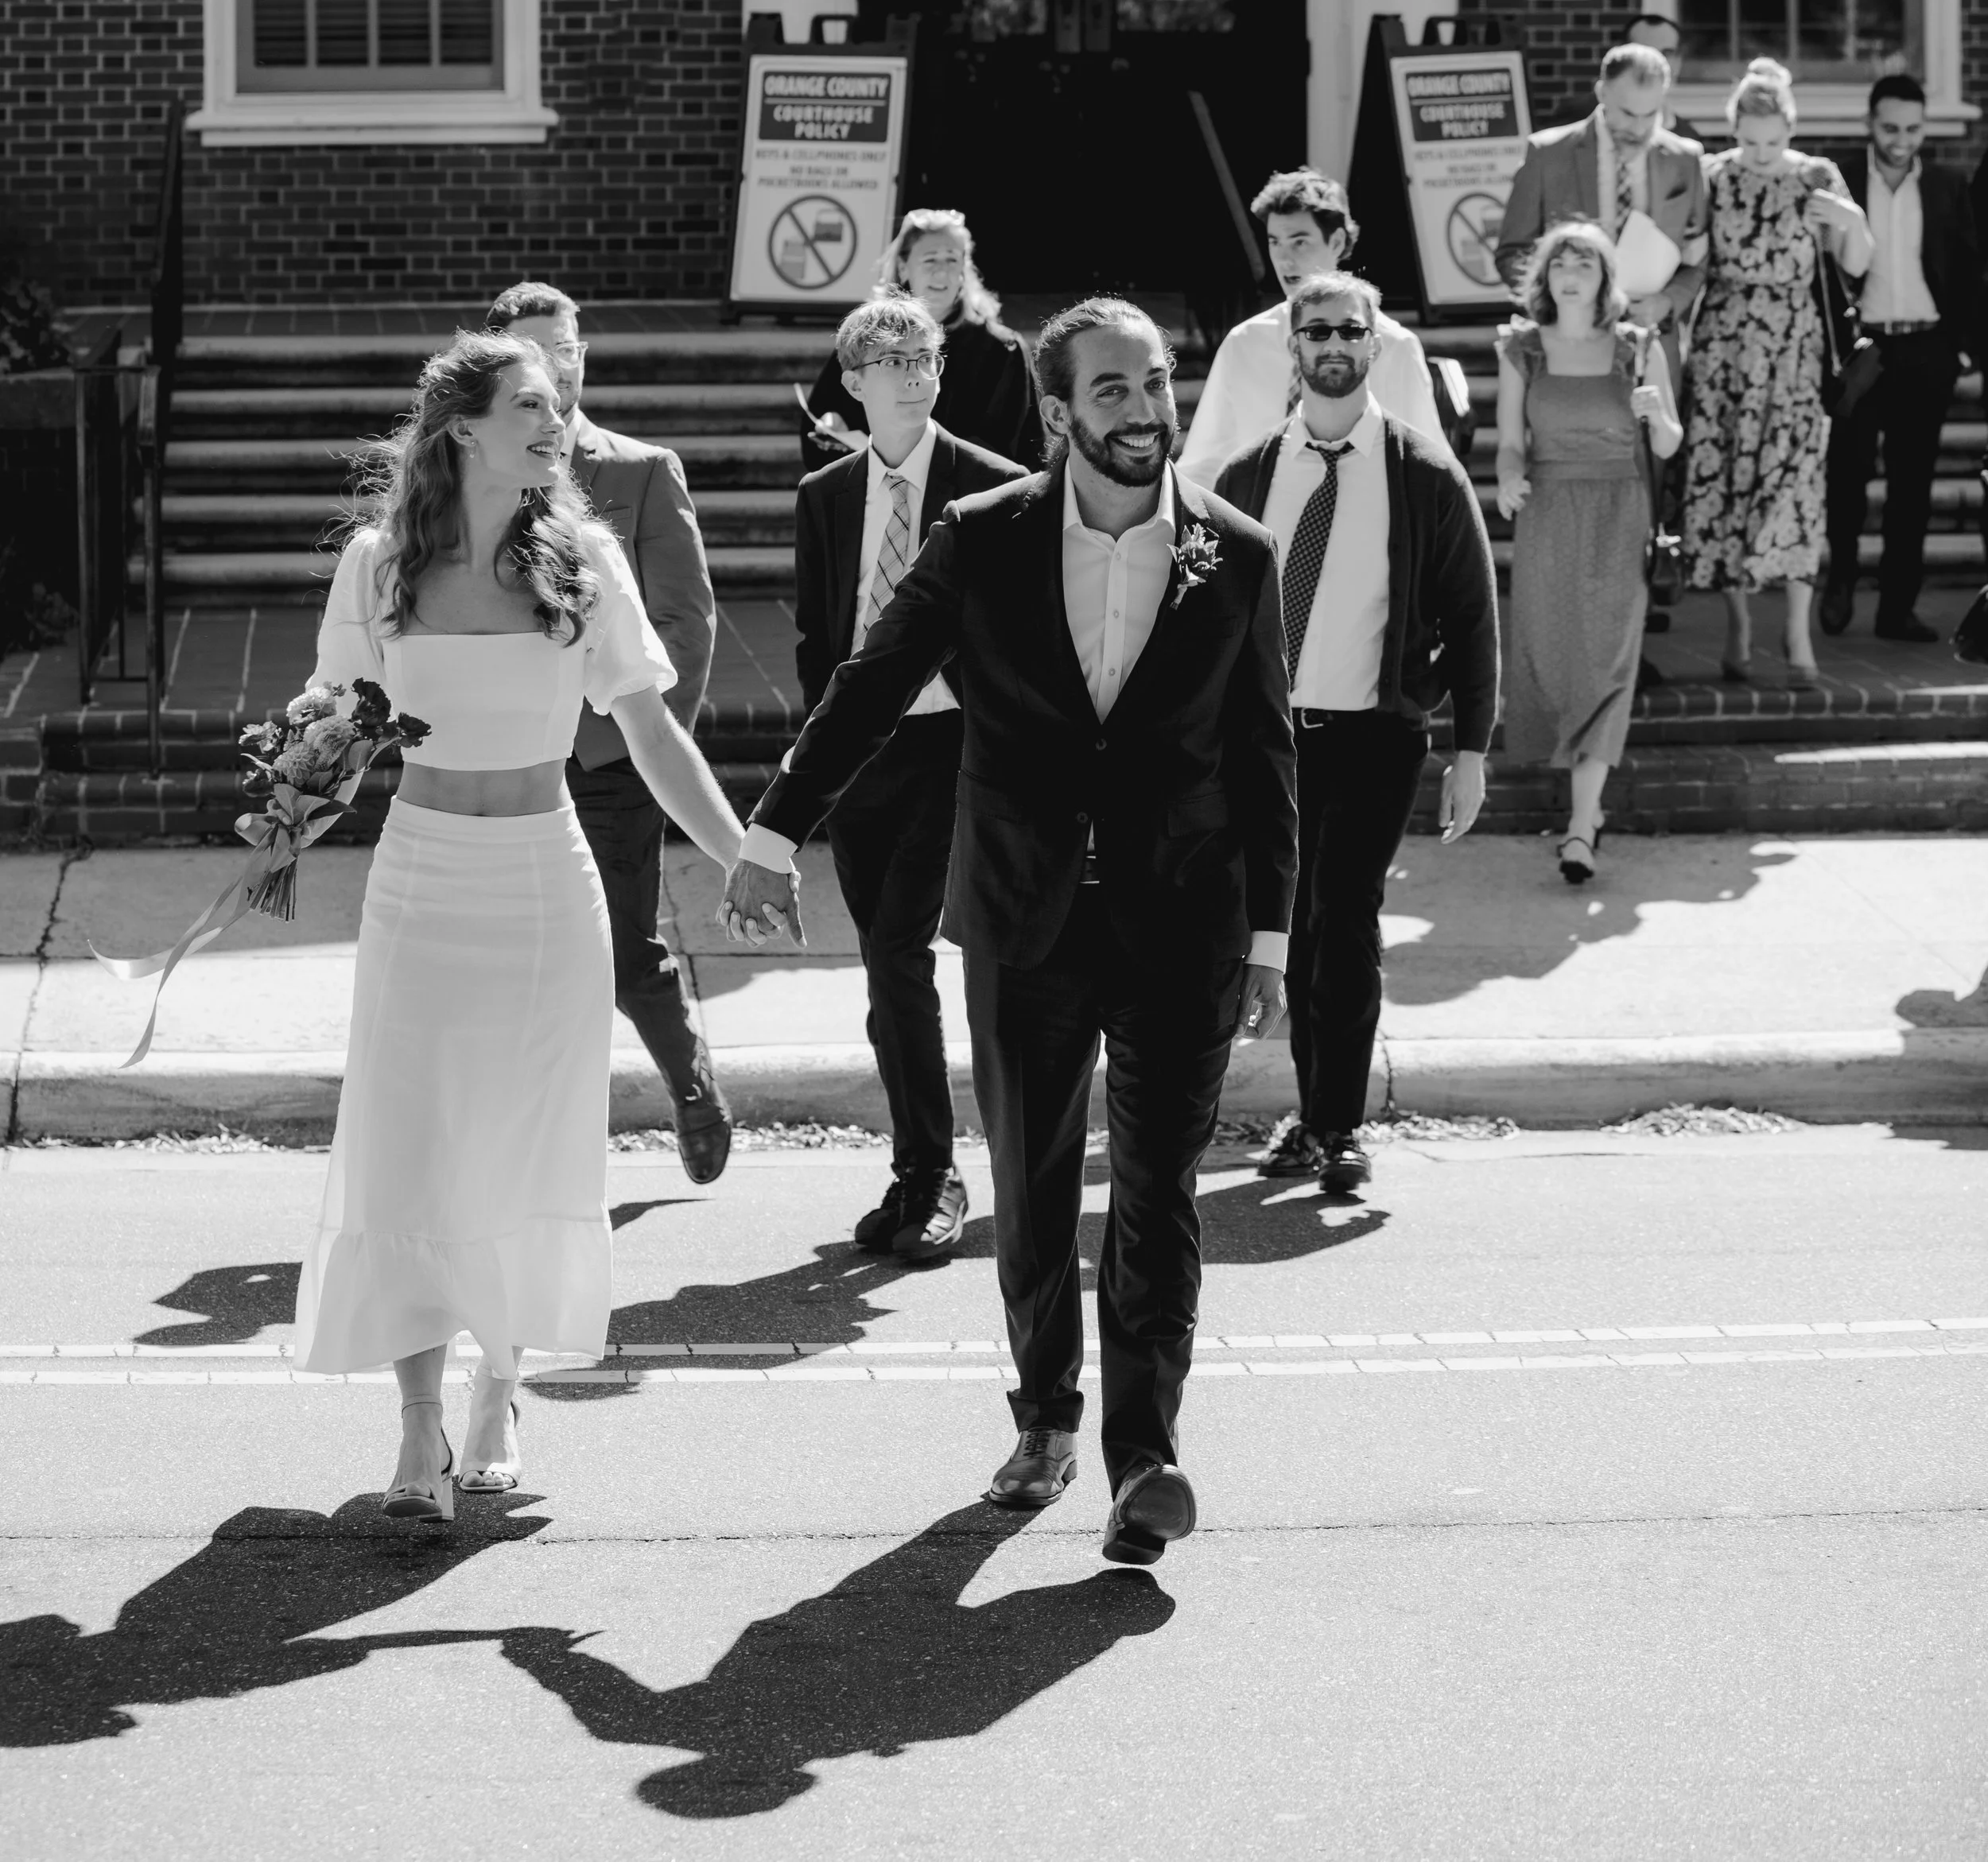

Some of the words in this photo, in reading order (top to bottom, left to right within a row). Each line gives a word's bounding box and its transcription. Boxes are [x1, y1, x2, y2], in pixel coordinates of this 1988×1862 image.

[764, 75, 825, 97] ORANGE
[827, 76, 888, 98] COUNTY
[1408, 75, 1460, 97] ORANGE
[1460, 72, 1509, 95] COUNTY
[773, 104, 872, 123] COURTHOUSE
[1420, 103, 1505, 122] COURTHOUSE
[794, 122, 850, 139] POLICY
[1442, 120, 1489, 138] POLICY
